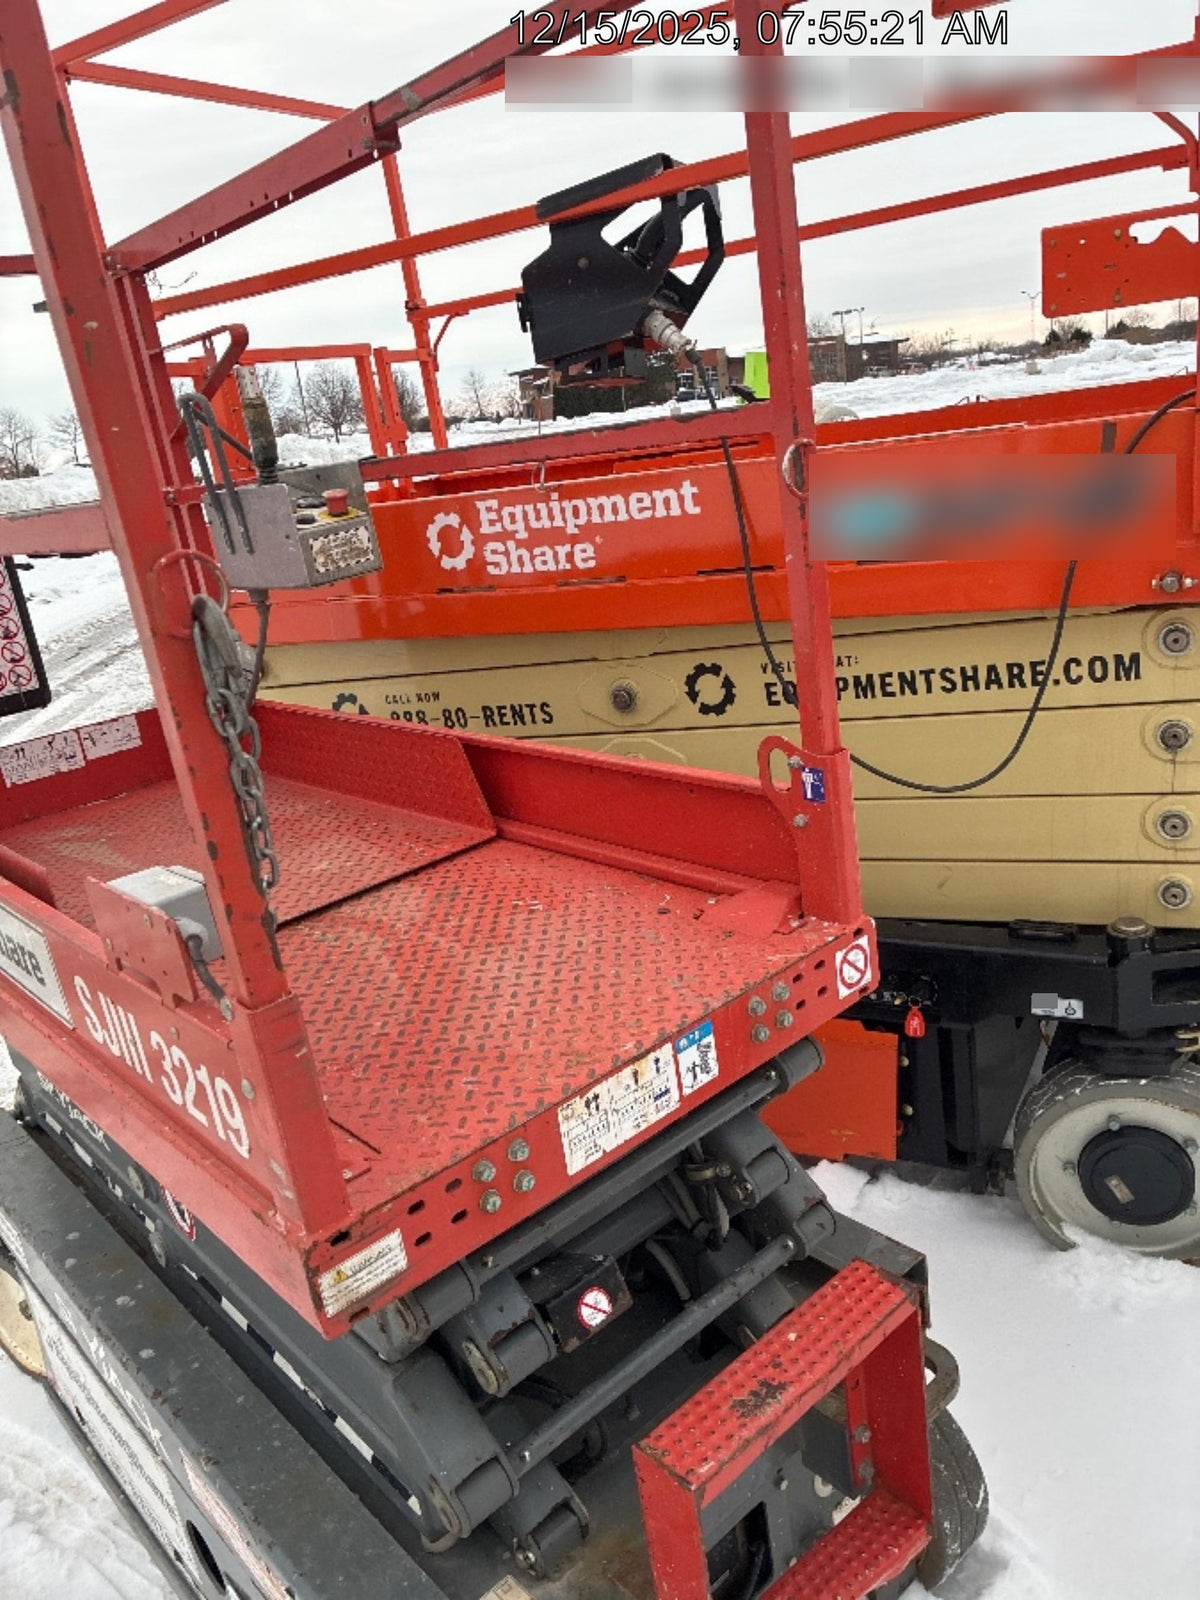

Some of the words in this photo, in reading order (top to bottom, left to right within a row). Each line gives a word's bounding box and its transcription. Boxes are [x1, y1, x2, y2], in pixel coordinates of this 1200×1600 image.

[475, 479, 701, 539] Equipment
[483, 540, 597, 575] Share
[760, 660, 796, 674] VSI
[764, 652, 1142, 706] EQPMENTSHARE.COM
[150, 1031, 249, 1160] 3219
